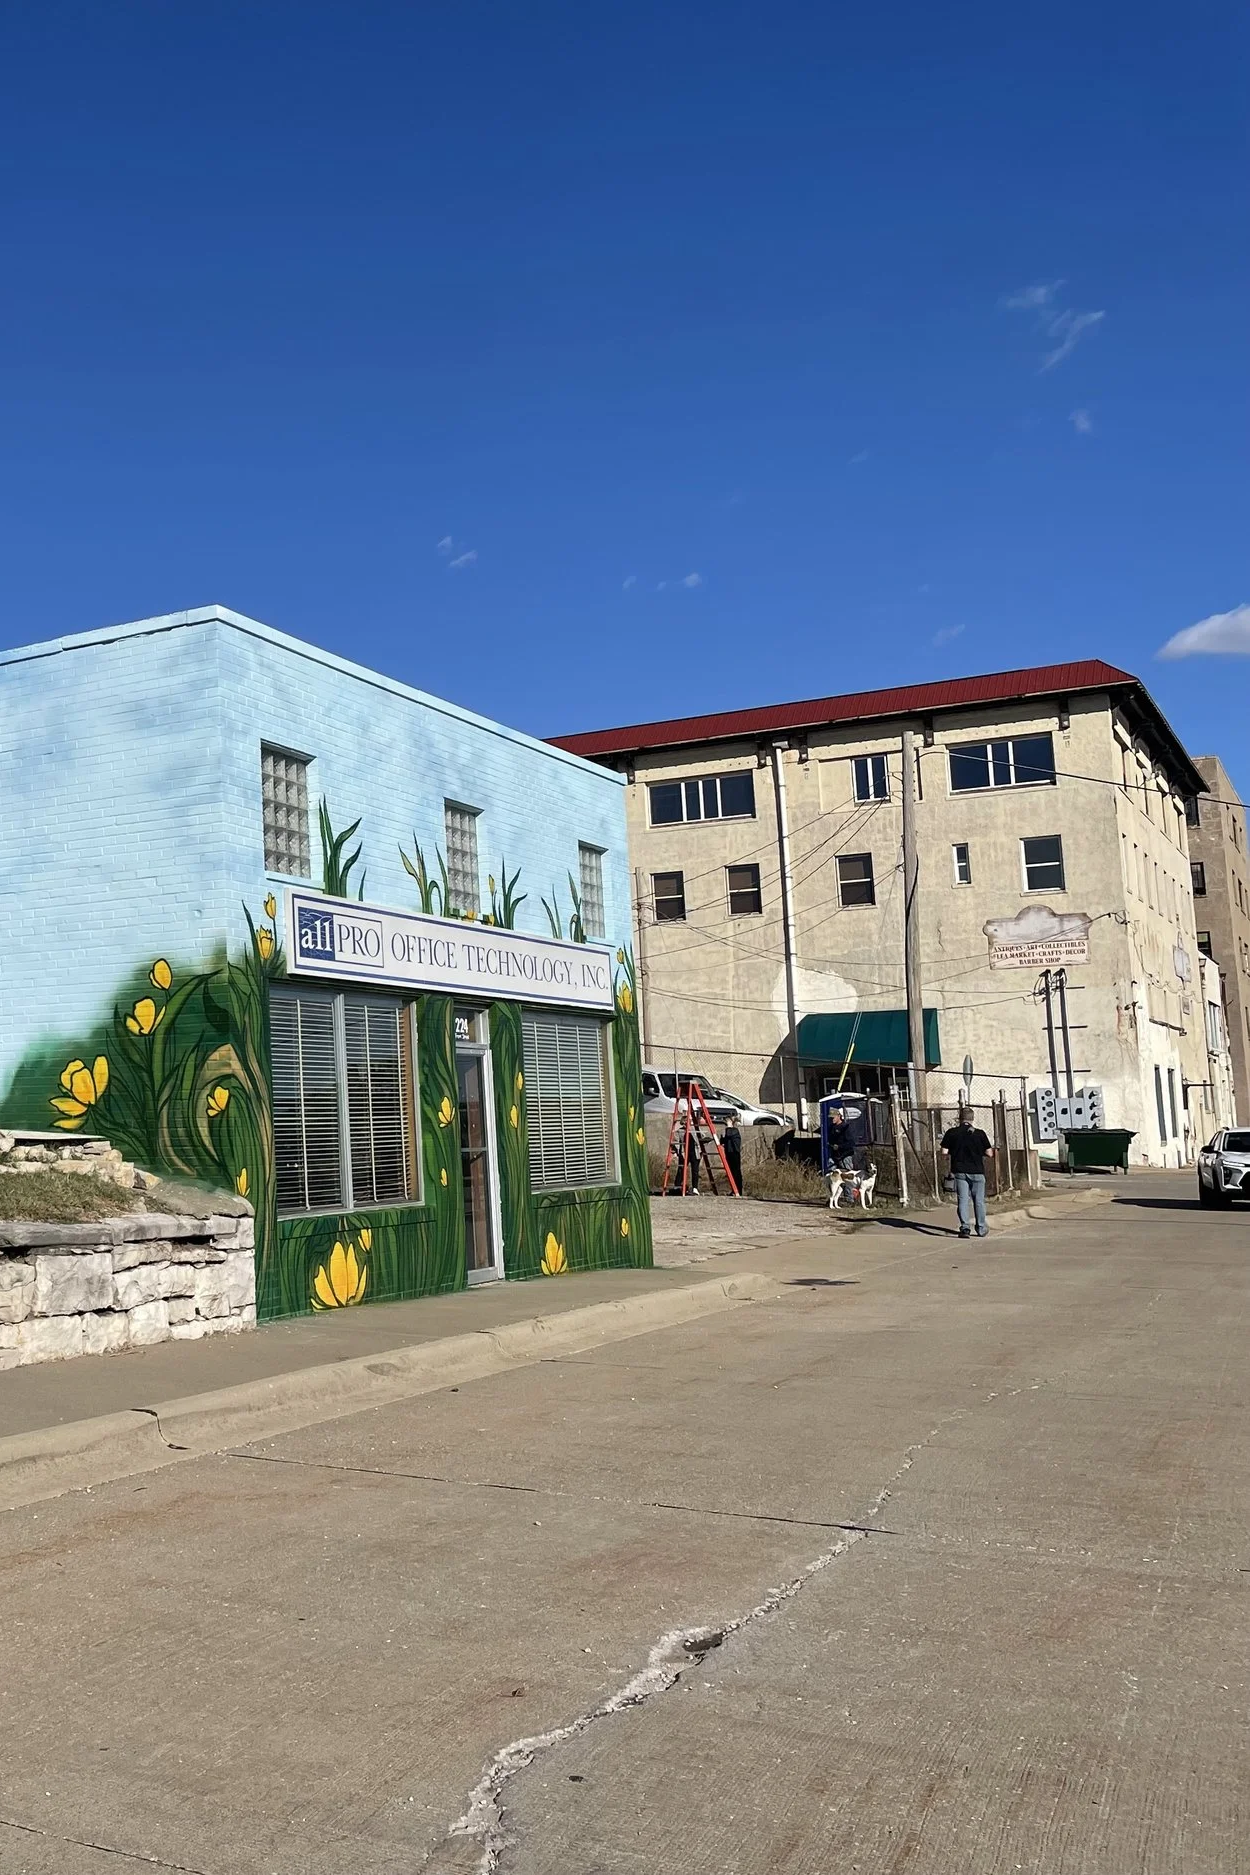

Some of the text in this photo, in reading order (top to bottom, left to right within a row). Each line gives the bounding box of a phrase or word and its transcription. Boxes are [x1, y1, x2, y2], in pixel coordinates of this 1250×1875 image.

[994, 941, 1086, 953] ANTIQUES ART COLLECTIBLES
[301, 919, 609, 990] all PRO OFFICE TECHNOLOGY, INC.
[1009, 951, 1035, 959] MARKET
[455, 1017, 468, 1033] 224
